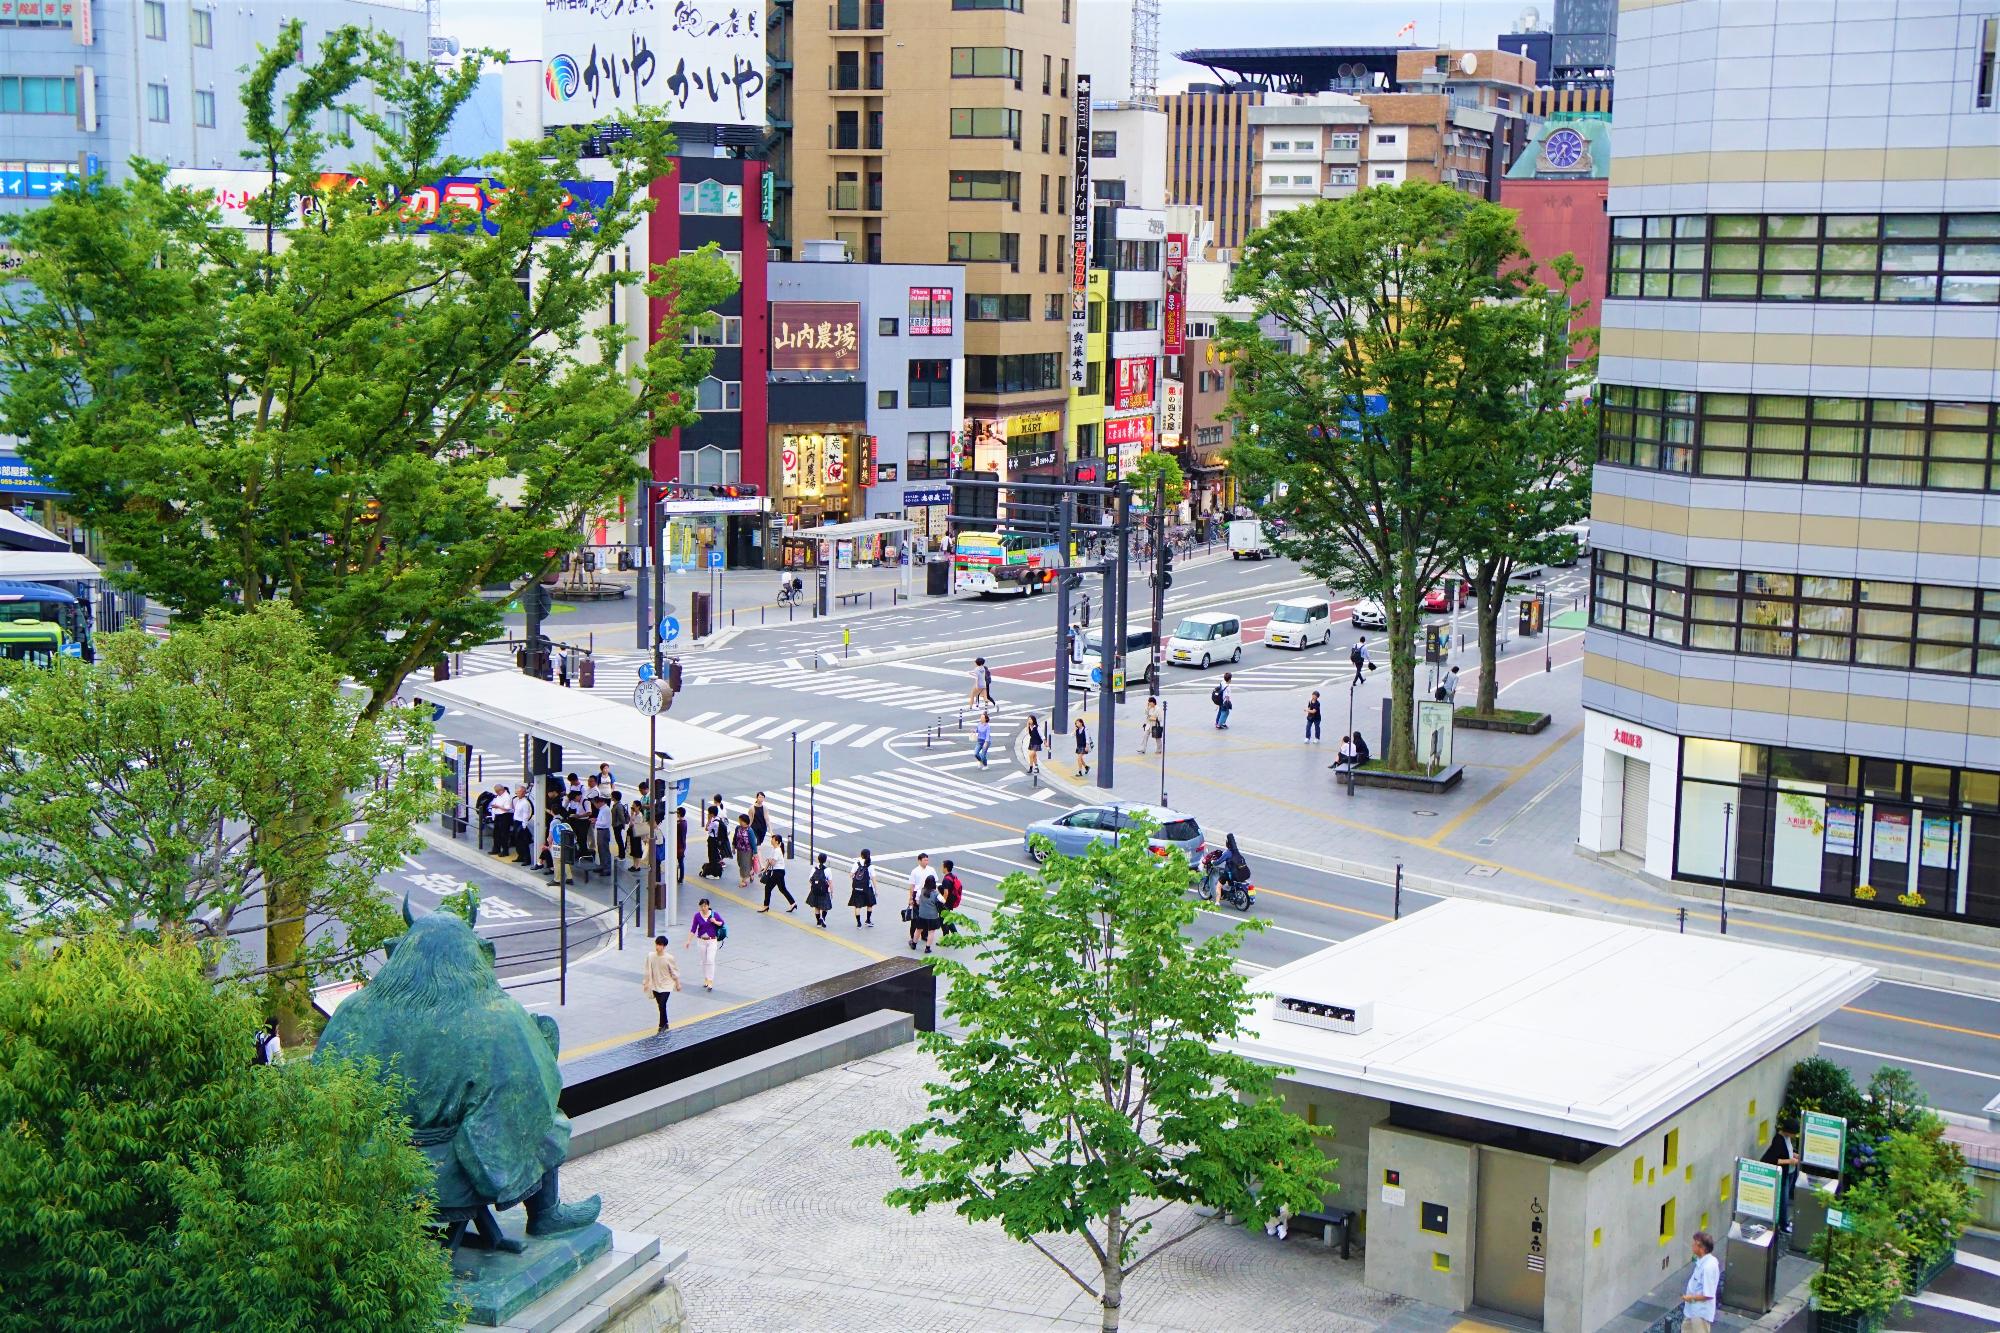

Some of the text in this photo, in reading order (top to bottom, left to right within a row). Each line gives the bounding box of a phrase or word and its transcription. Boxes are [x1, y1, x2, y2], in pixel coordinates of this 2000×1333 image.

[667, 53, 763, 120] かいや
[1076, 136, 1087, 211] たちばな
[774, 321, 856, 350] 山内農場
[713, 554, 721, 566] P
